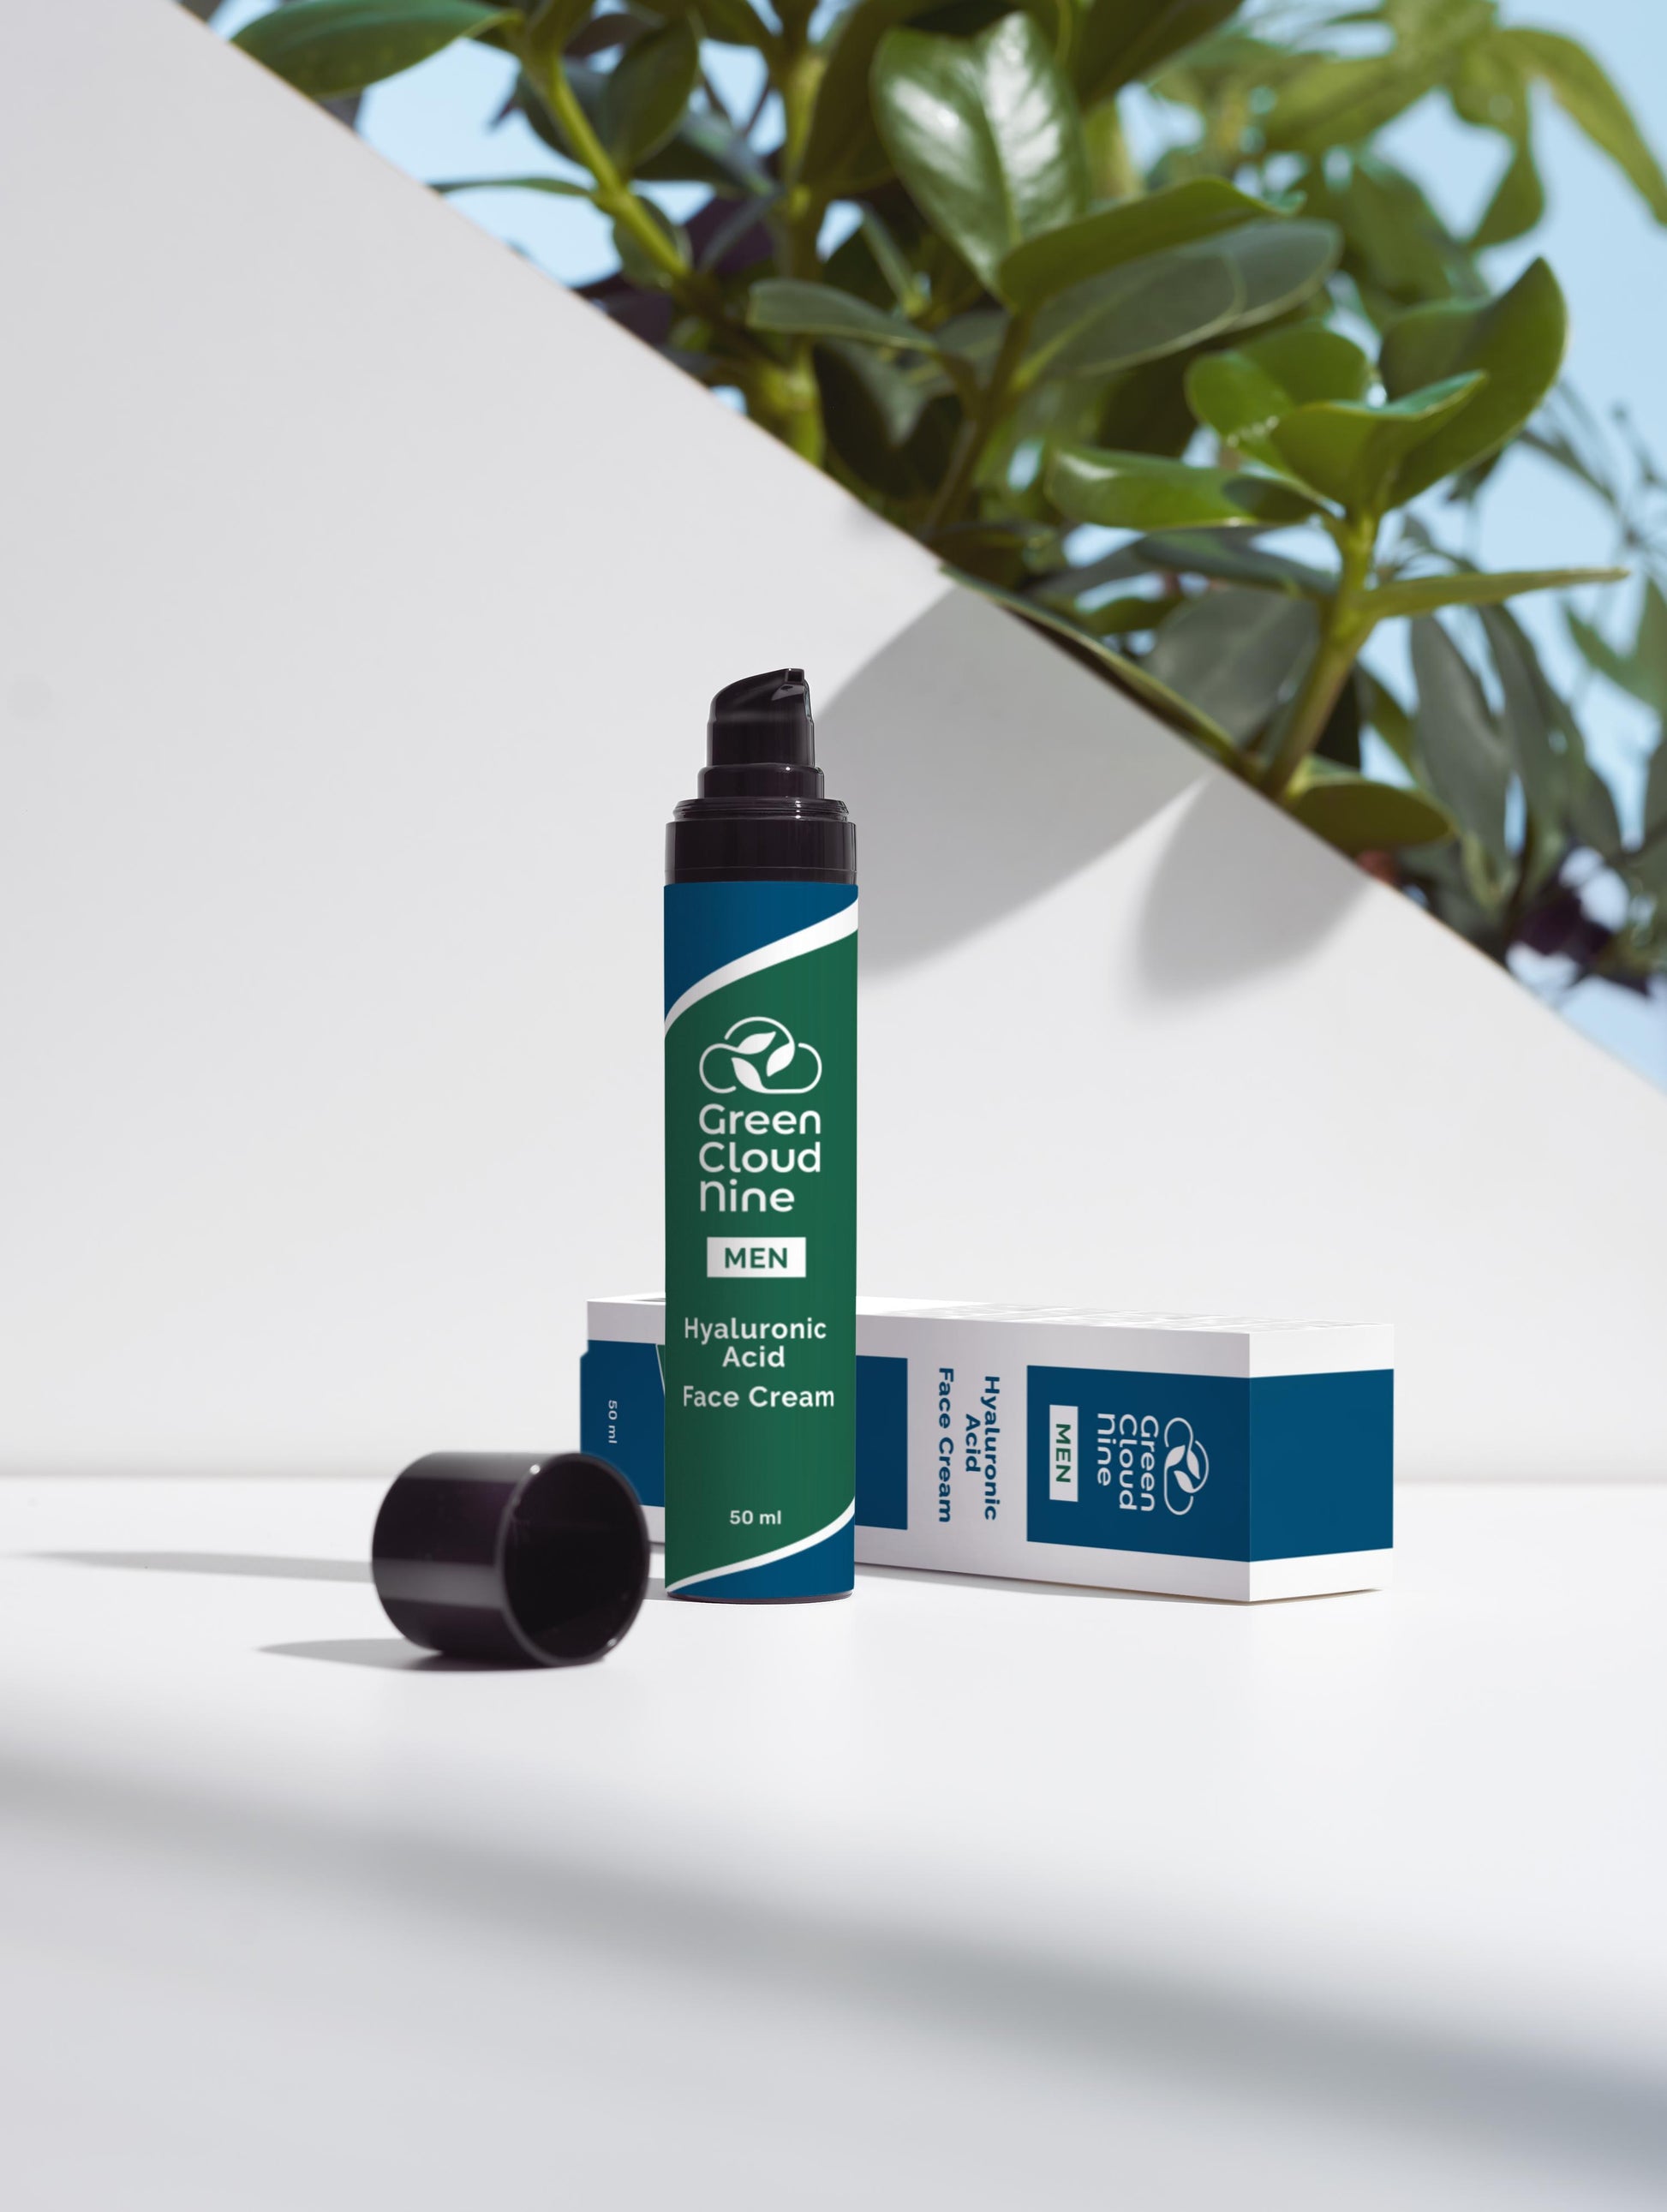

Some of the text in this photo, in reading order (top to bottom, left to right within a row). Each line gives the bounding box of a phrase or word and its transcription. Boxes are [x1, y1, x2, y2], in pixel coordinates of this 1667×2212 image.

[699, 1103, 822, 1135] Green
[699, 1141, 821, 1173] Cloud
[724, 1246, 788, 1269] MEN
[684, 1317, 827, 1345] Hyaluronic
[722, 1345, 786, 1368] Acid
[683, 1384, 834, 1408] Face Cream
[608, 1400, 618, 1444] 50 ml
[938, 1367, 954, 1523] Face Cream
[965, 1414, 981, 1473] Acid
[981, 1376, 1001, 1521] Hyaluronic
[1055, 1423, 1072, 1483] MEN
[1119, 1414, 1138, 1510] Cloud
[1140, 1414, 1159, 1512] Green
[729, 1510, 782, 1525] 50 ml
